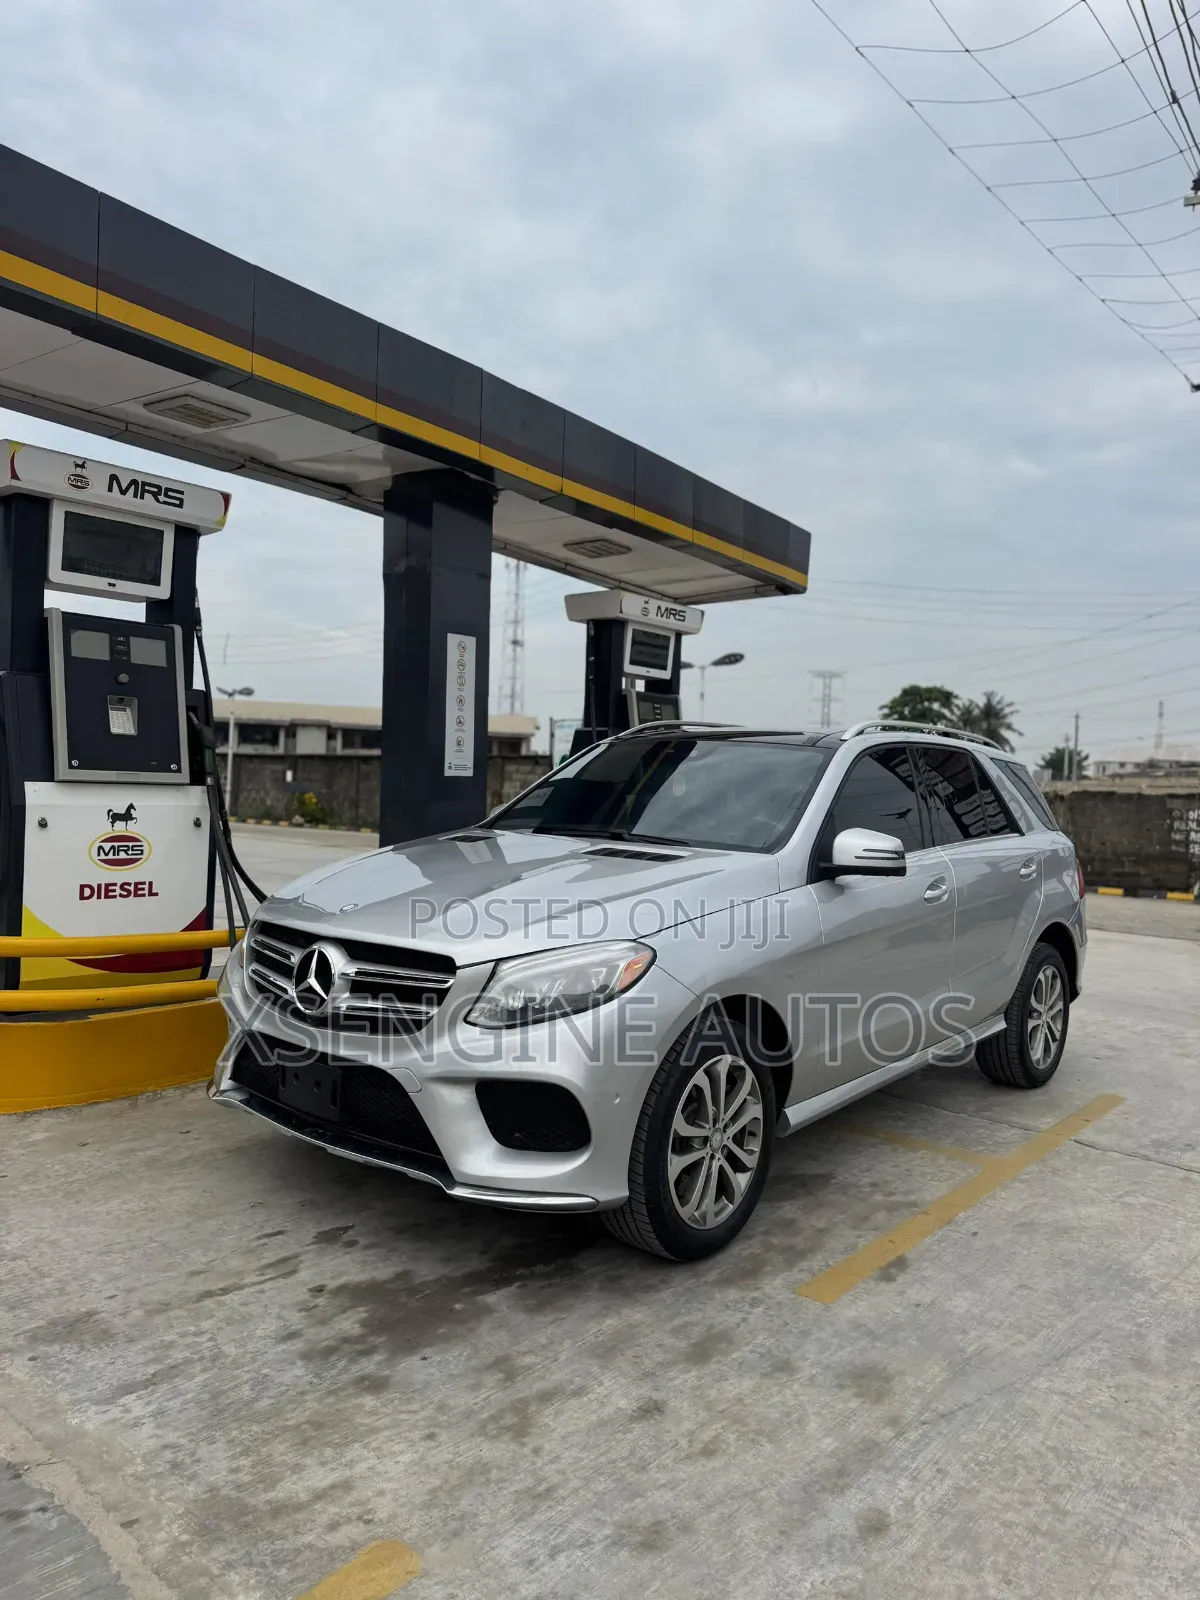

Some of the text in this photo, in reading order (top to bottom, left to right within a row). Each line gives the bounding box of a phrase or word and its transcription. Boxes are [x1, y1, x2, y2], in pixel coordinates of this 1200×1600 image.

[67, 476, 90, 487] MRS
[107, 473, 185, 509] MRS
[655, 604, 687, 623] MRS
[96, 844, 144, 857] MRS
[78, 880, 159, 901] DIESEL
